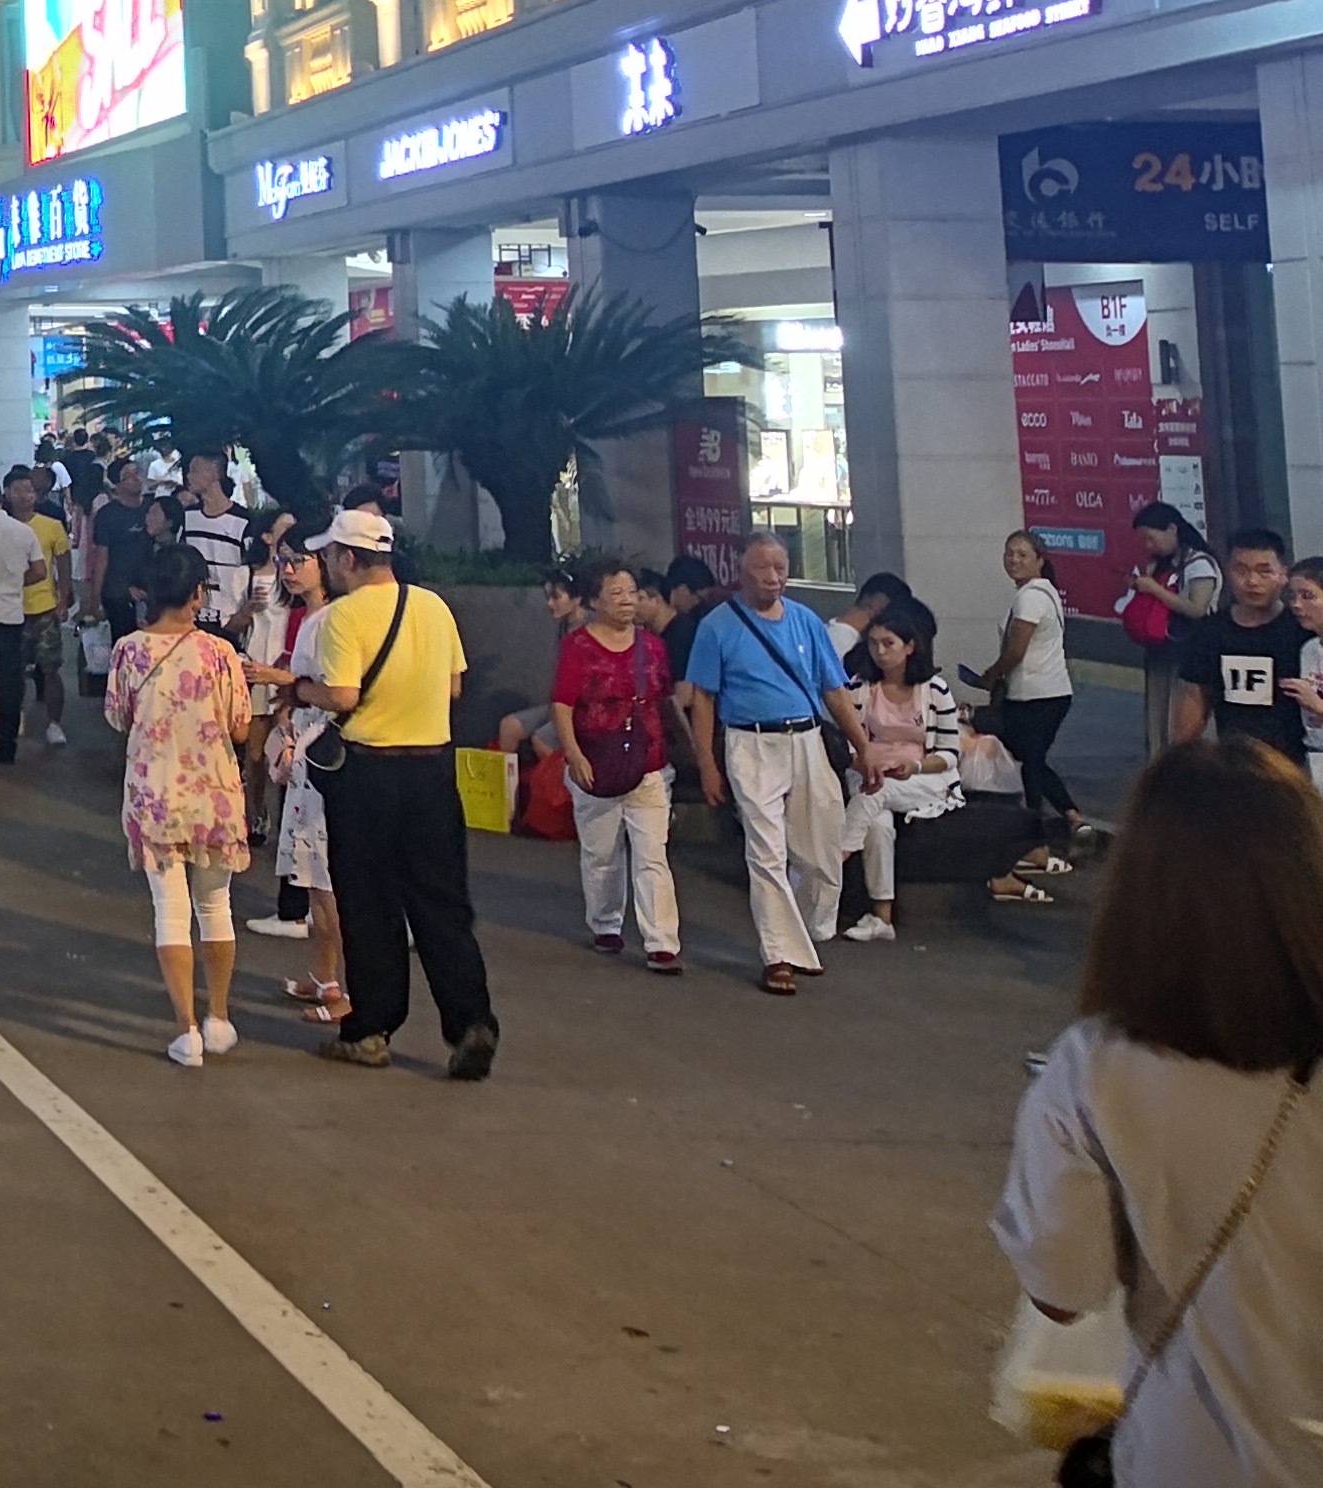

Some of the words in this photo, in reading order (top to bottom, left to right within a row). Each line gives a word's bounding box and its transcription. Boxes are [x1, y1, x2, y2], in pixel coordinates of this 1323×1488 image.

[989, 8, 1041, 39] SEAFOOD
[1204, 212, 1260, 232] SELF
[1100, 295, 1128, 320] B1F
